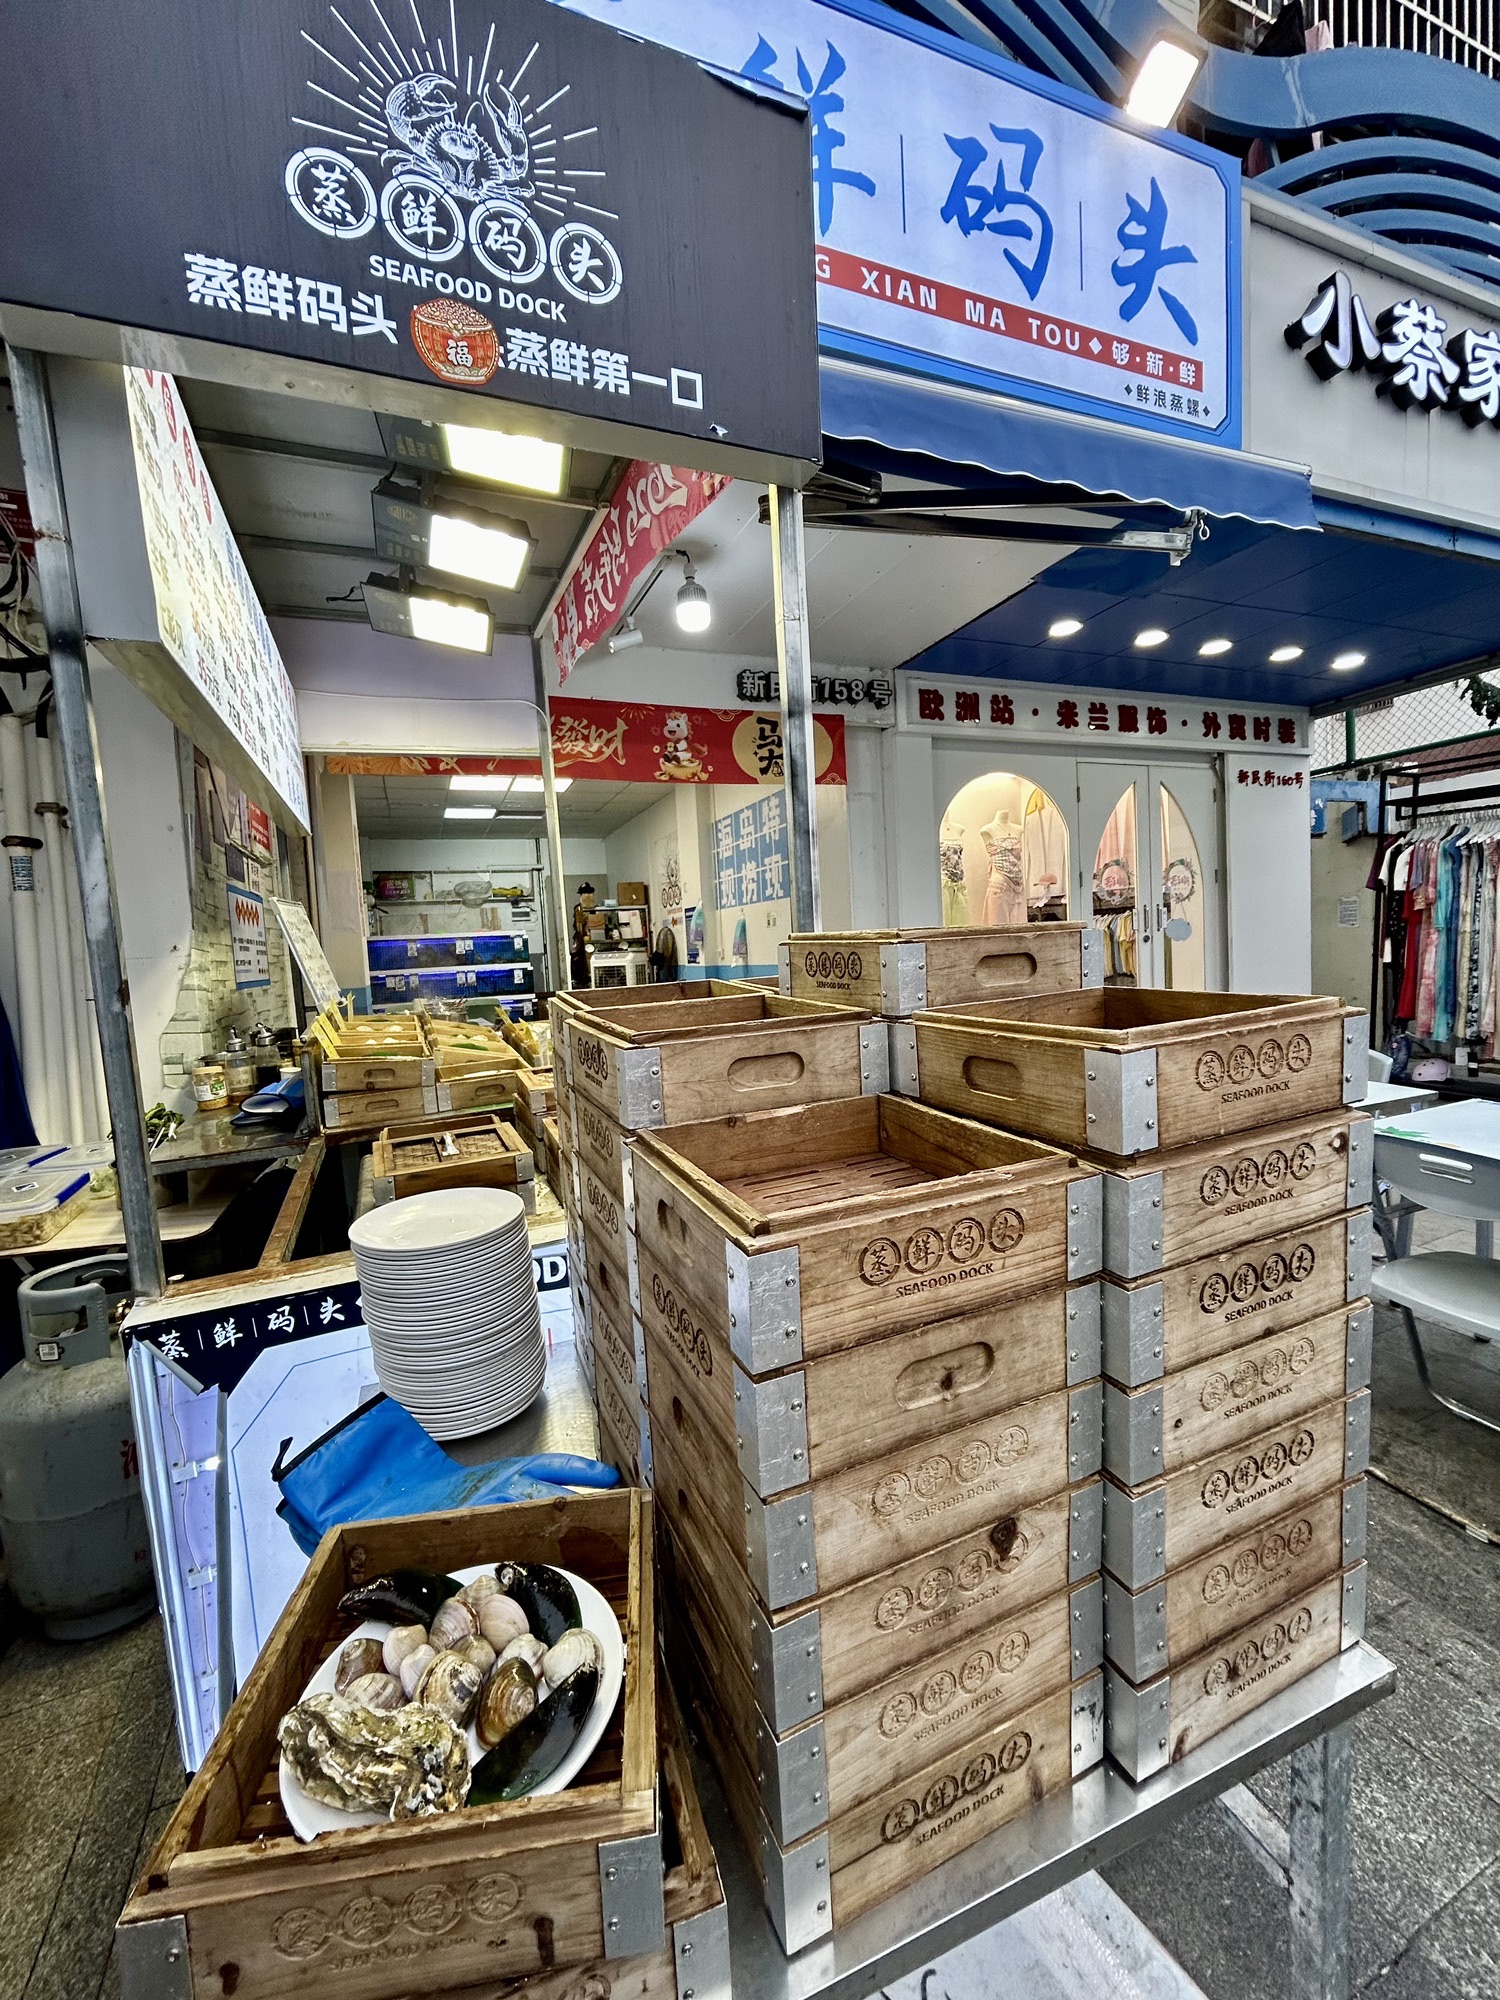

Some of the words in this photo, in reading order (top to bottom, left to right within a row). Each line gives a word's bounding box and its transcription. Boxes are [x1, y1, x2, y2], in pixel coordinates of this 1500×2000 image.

[298, 155, 614, 298] 蒸鲜码头
[183, 252, 399, 344] 蒸鲜码头
[369, 254, 493, 303] SEAFOOD
[498, 287, 567, 322] DOCK
[860, 266, 937, 310] XIAN
[964, 298, 1006, 331] MA
[1027, 317, 1081, 351] TOU
[446, 339, 474, 368] 福
[505, 327, 704, 409] 蒸鲜第一口
[1136, 384, 1200, 418] 鲜浪蒸螺
[741, 670, 893, 705] 新158号
[865, 1214, 1019, 1281] 蒸鲜码头
[895, 1273, 957, 1298] SEAFOOD
[958, 1262, 996, 1281] DOCK
[157, 1296, 346, 1361] 蒸鲜码头
[1224, 1300, 1267, 1323] SEAFOOD
[1267, 1290, 1294, 1307] DOCK
[914, 1805, 970, 1845] SEAFOOD
[971, 1783, 1005, 1812] DOCK
